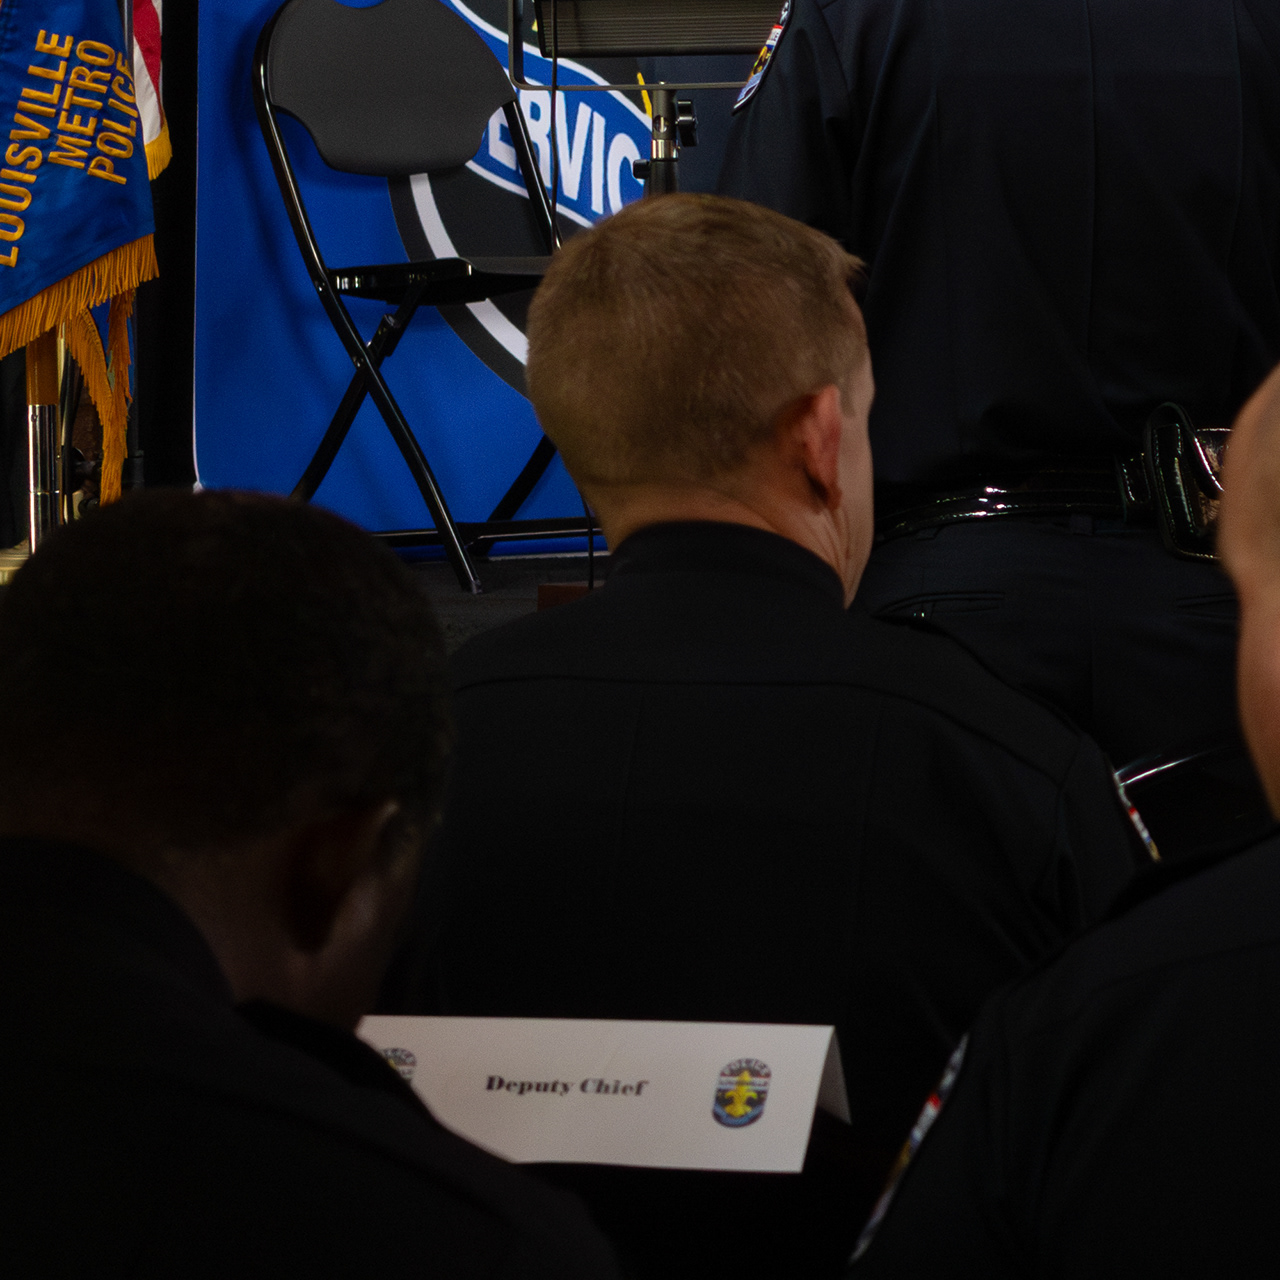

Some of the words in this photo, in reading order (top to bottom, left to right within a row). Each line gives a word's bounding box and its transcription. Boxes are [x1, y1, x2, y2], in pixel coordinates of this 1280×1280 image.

[48, 40, 116, 169] METRO
[87, 52, 139, 185] POLICE
[488, 77, 646, 217] ERVIC
[485, 1075, 575, 1097] Deputy
[580, 1077, 650, 1096] Chief
